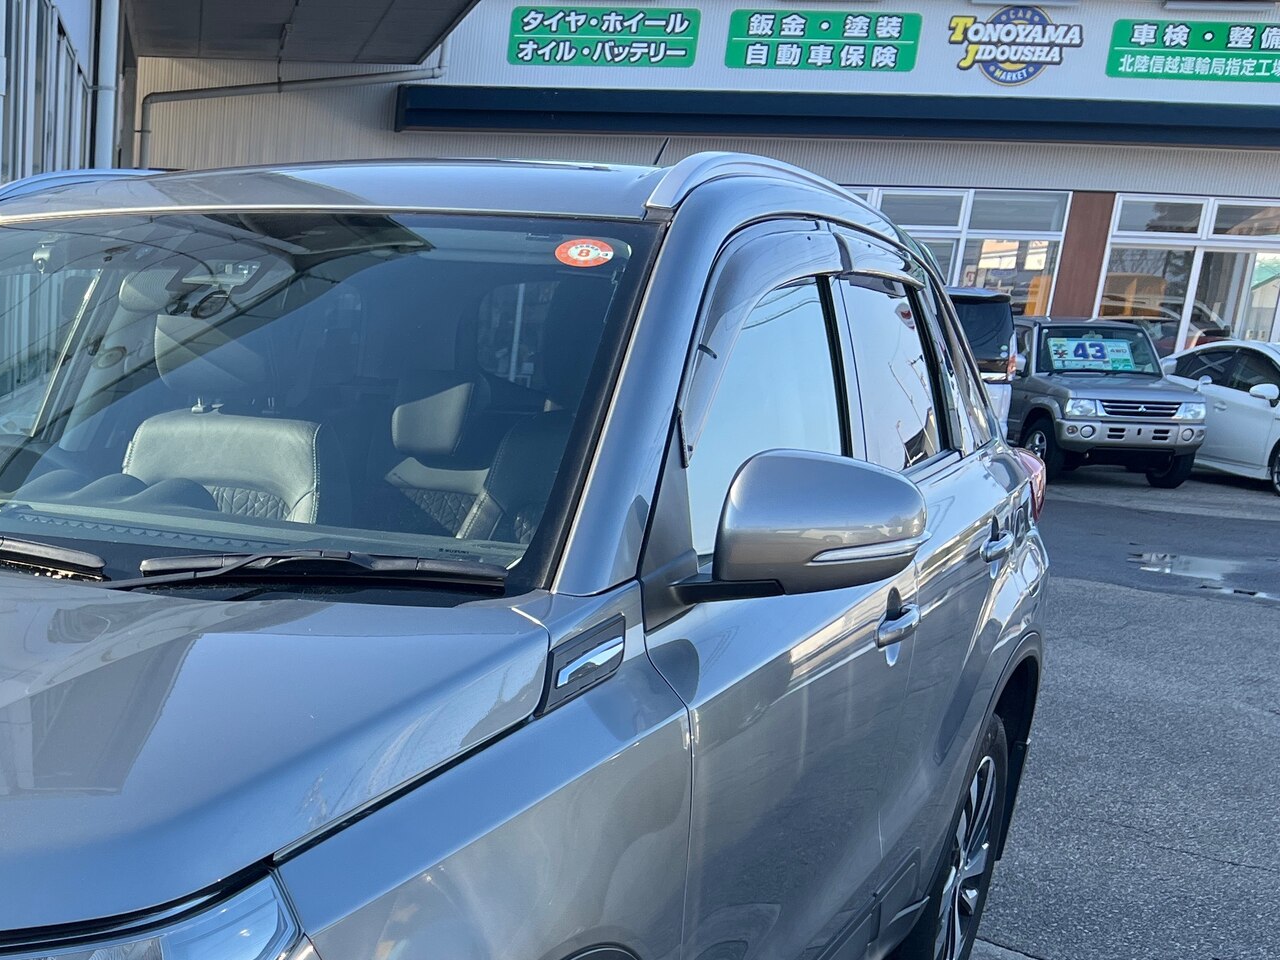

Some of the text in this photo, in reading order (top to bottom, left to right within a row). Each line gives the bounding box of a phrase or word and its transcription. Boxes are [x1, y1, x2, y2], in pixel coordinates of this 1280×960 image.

[522, 11, 689, 34] タイヤ・ホイール
[748, 13, 904, 39] 鈑金・塗装
[1009, 10, 1032, 20] CAR
[948, 15, 1083, 47] TONOYAMA
[518, 40, 686, 63] オイル・バッテリー
[745, 43, 898, 69] 自動車保険
[957, 44, 1063, 70] JIDOUSHA
[994, 69, 1028, 81] MARKET
[1073, 342, 1107, 359] 43
